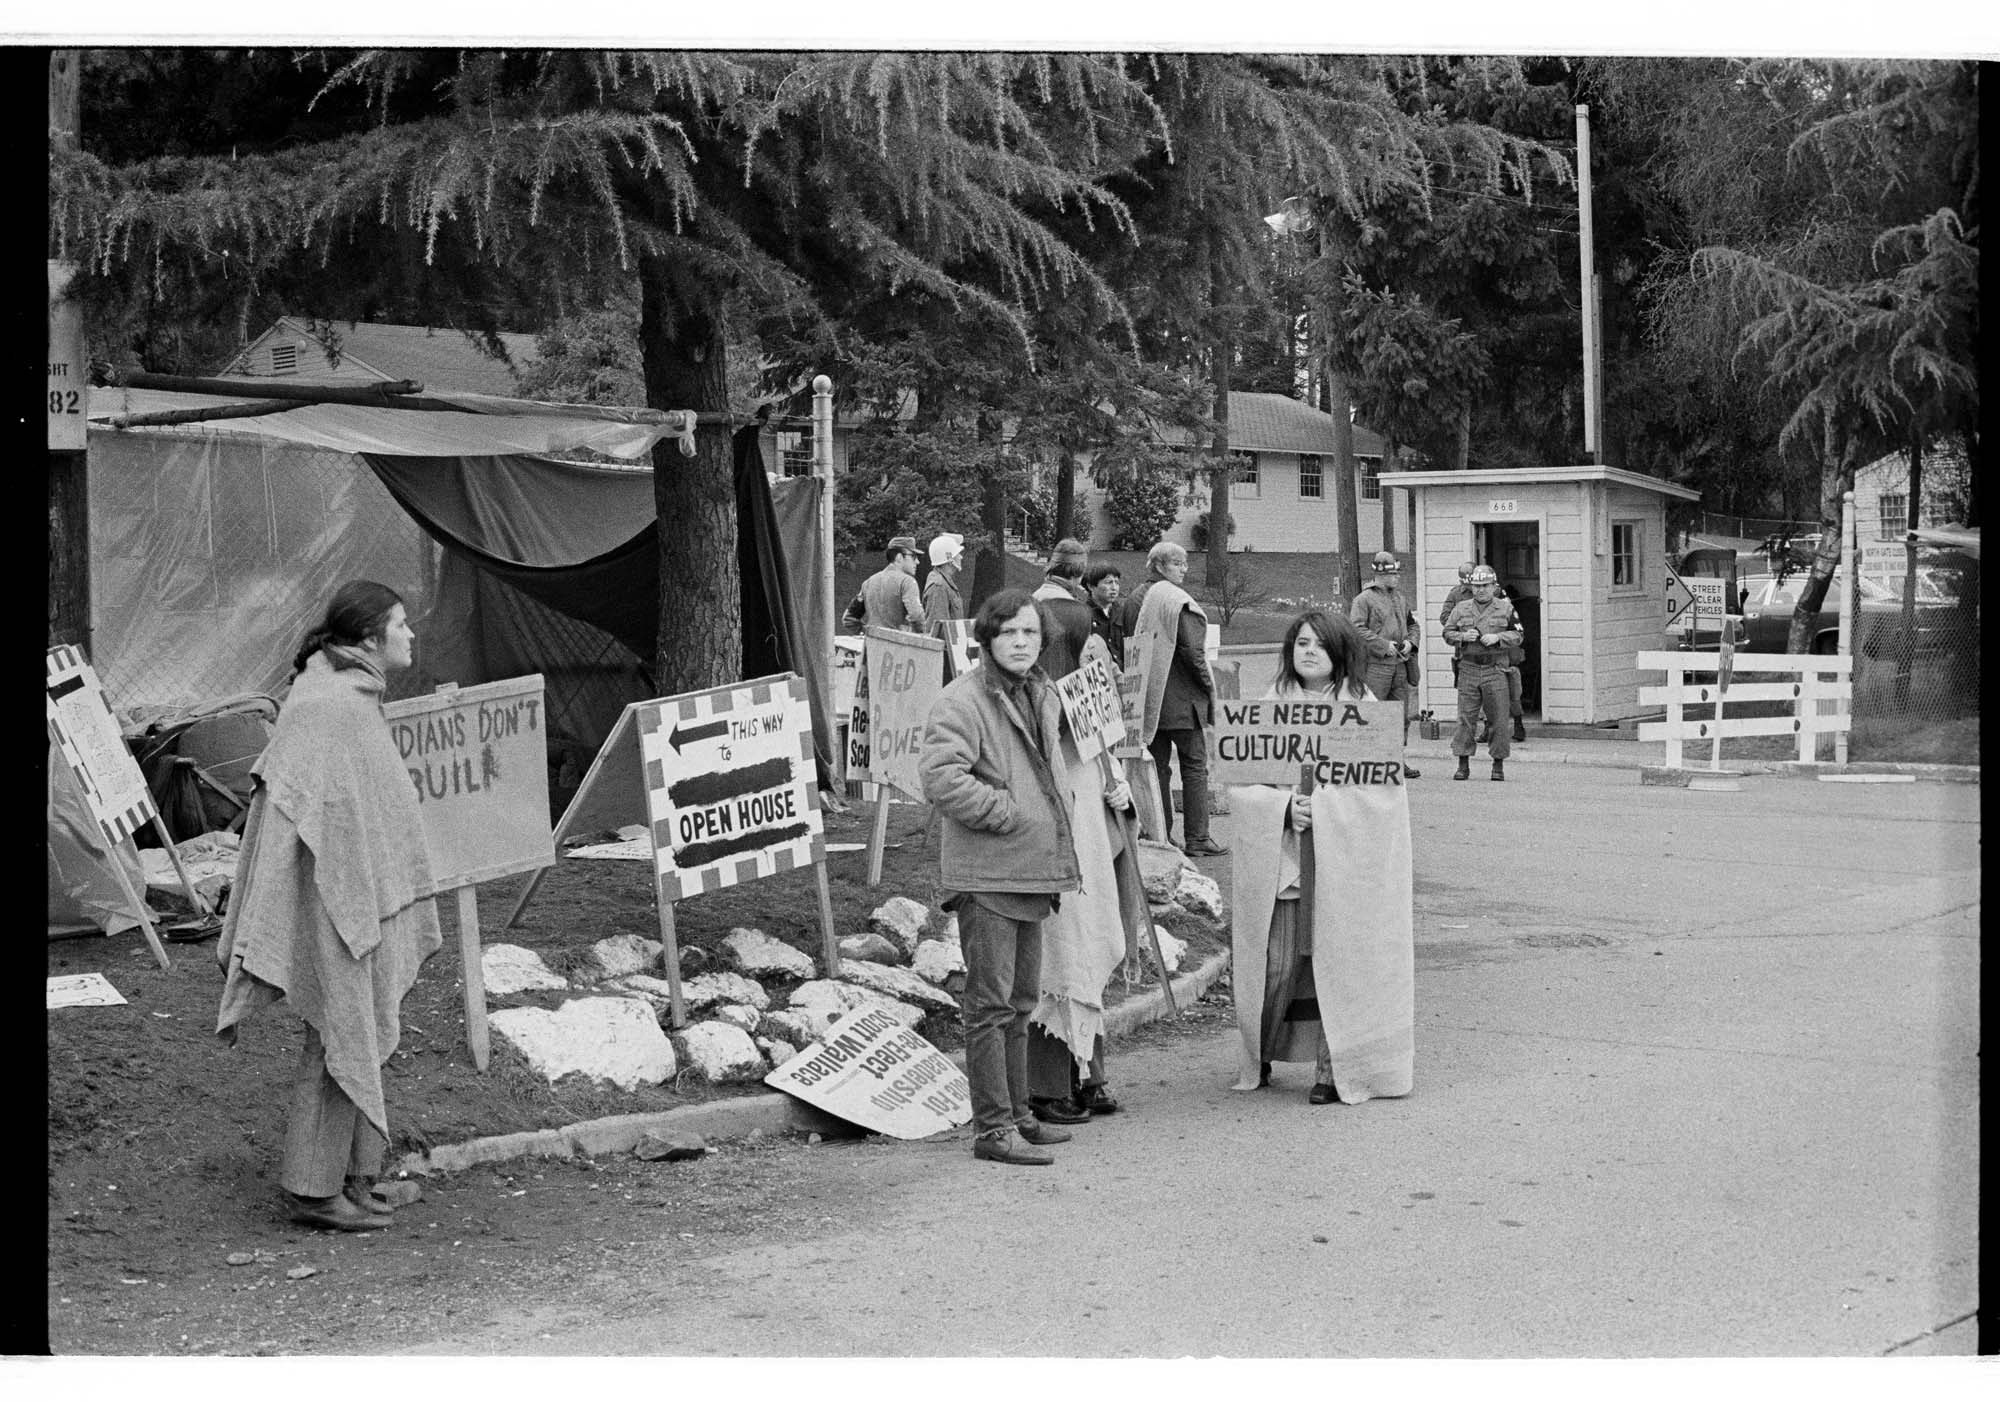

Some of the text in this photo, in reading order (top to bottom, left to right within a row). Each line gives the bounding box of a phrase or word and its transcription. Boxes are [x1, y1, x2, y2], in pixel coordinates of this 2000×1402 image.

[50, 391, 79, 414] 82
[1494, 502, 1513, 511] 668
[1666, 577, 1675, 591] P
[1692, 585, 1721, 593] STREET
[1667, 599, 1676, 613] D
[1695, 607, 1722, 615] EHICLES
[1696, 596, 1722, 604] CLEAR
[879, 651, 915, 692] RED
[1063, 673, 1085, 701] WHO
[1084, 661, 1108, 692] HAS
[479, 700, 540, 743] DON'T
[732, 712, 784, 741] THIS WAY
[1069, 696, 1098, 742] MORE
[1223, 703, 1368, 726] WE NEED A
[718, 744, 732, 761] to
[1218, 733, 1330, 763] CULTURAL
[1315, 761, 1401, 786] CENTER
[679, 790, 796, 843] OPEN HOUSE
[849, 1009, 900, 1042] Scott
[790, 1034, 867, 1087] Wallace
[859, 1029, 928, 1080] Re-Elect
[870, 1051, 957, 1111] Leadership
[921, 1090, 960, 1116] For
